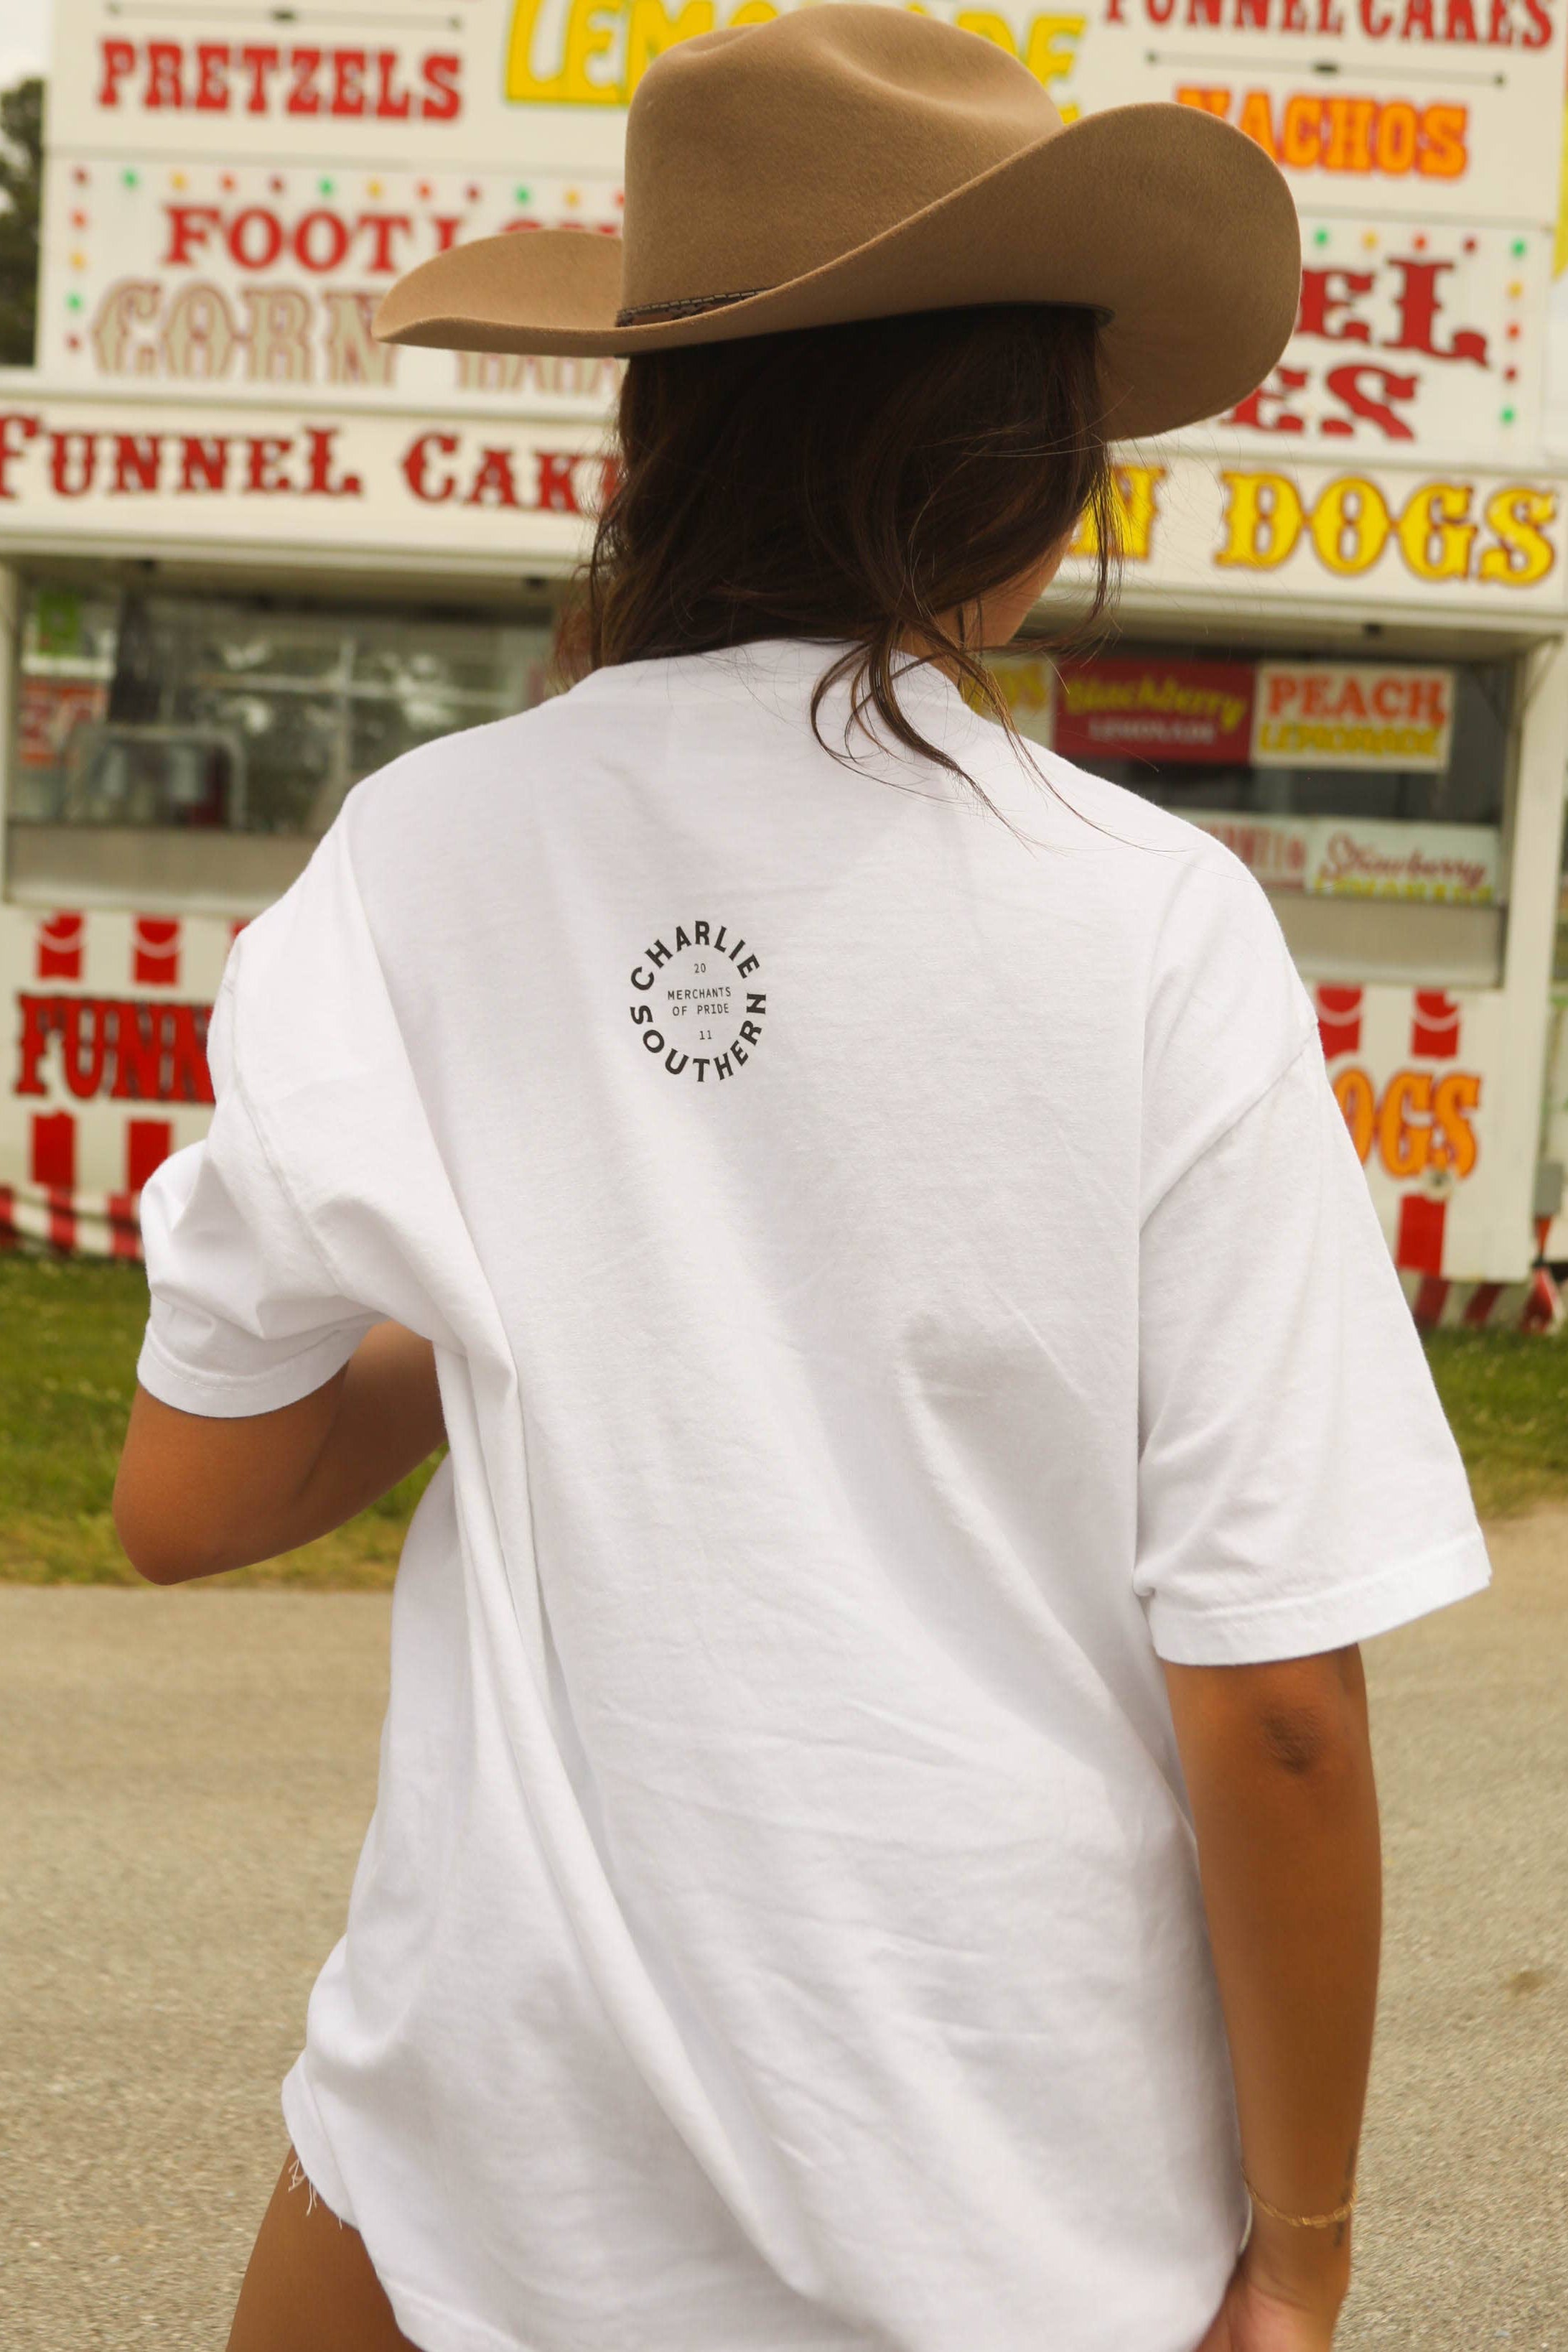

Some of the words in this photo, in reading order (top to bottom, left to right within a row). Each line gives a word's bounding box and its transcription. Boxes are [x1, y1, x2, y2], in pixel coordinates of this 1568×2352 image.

[98, 38, 463, 122] PRETZELS
[1174, 83, 1470, 184] ACHOS
[0, 412, 363, 501] FUNNEL
[400, 430, 626, 519] CAK
[1215, 469, 1557, 588] DOGS
[1267, 674, 1446, 729] PEACH
[630, 920, 760, 991] CHARLIE
[668, 986, 732, 1000] MERCHANTS
[694, 963, 706, 974] 20
[14, 990, 216, 1106] FUNN
[630, 993, 767, 1082] SOUTHERN
[672, 1005, 688, 1016] OF
[697, 1003, 729, 1015] PRIDE
[699, 1030, 712, 1040] 11
[1327, 1066, 1483, 1181] OGS
